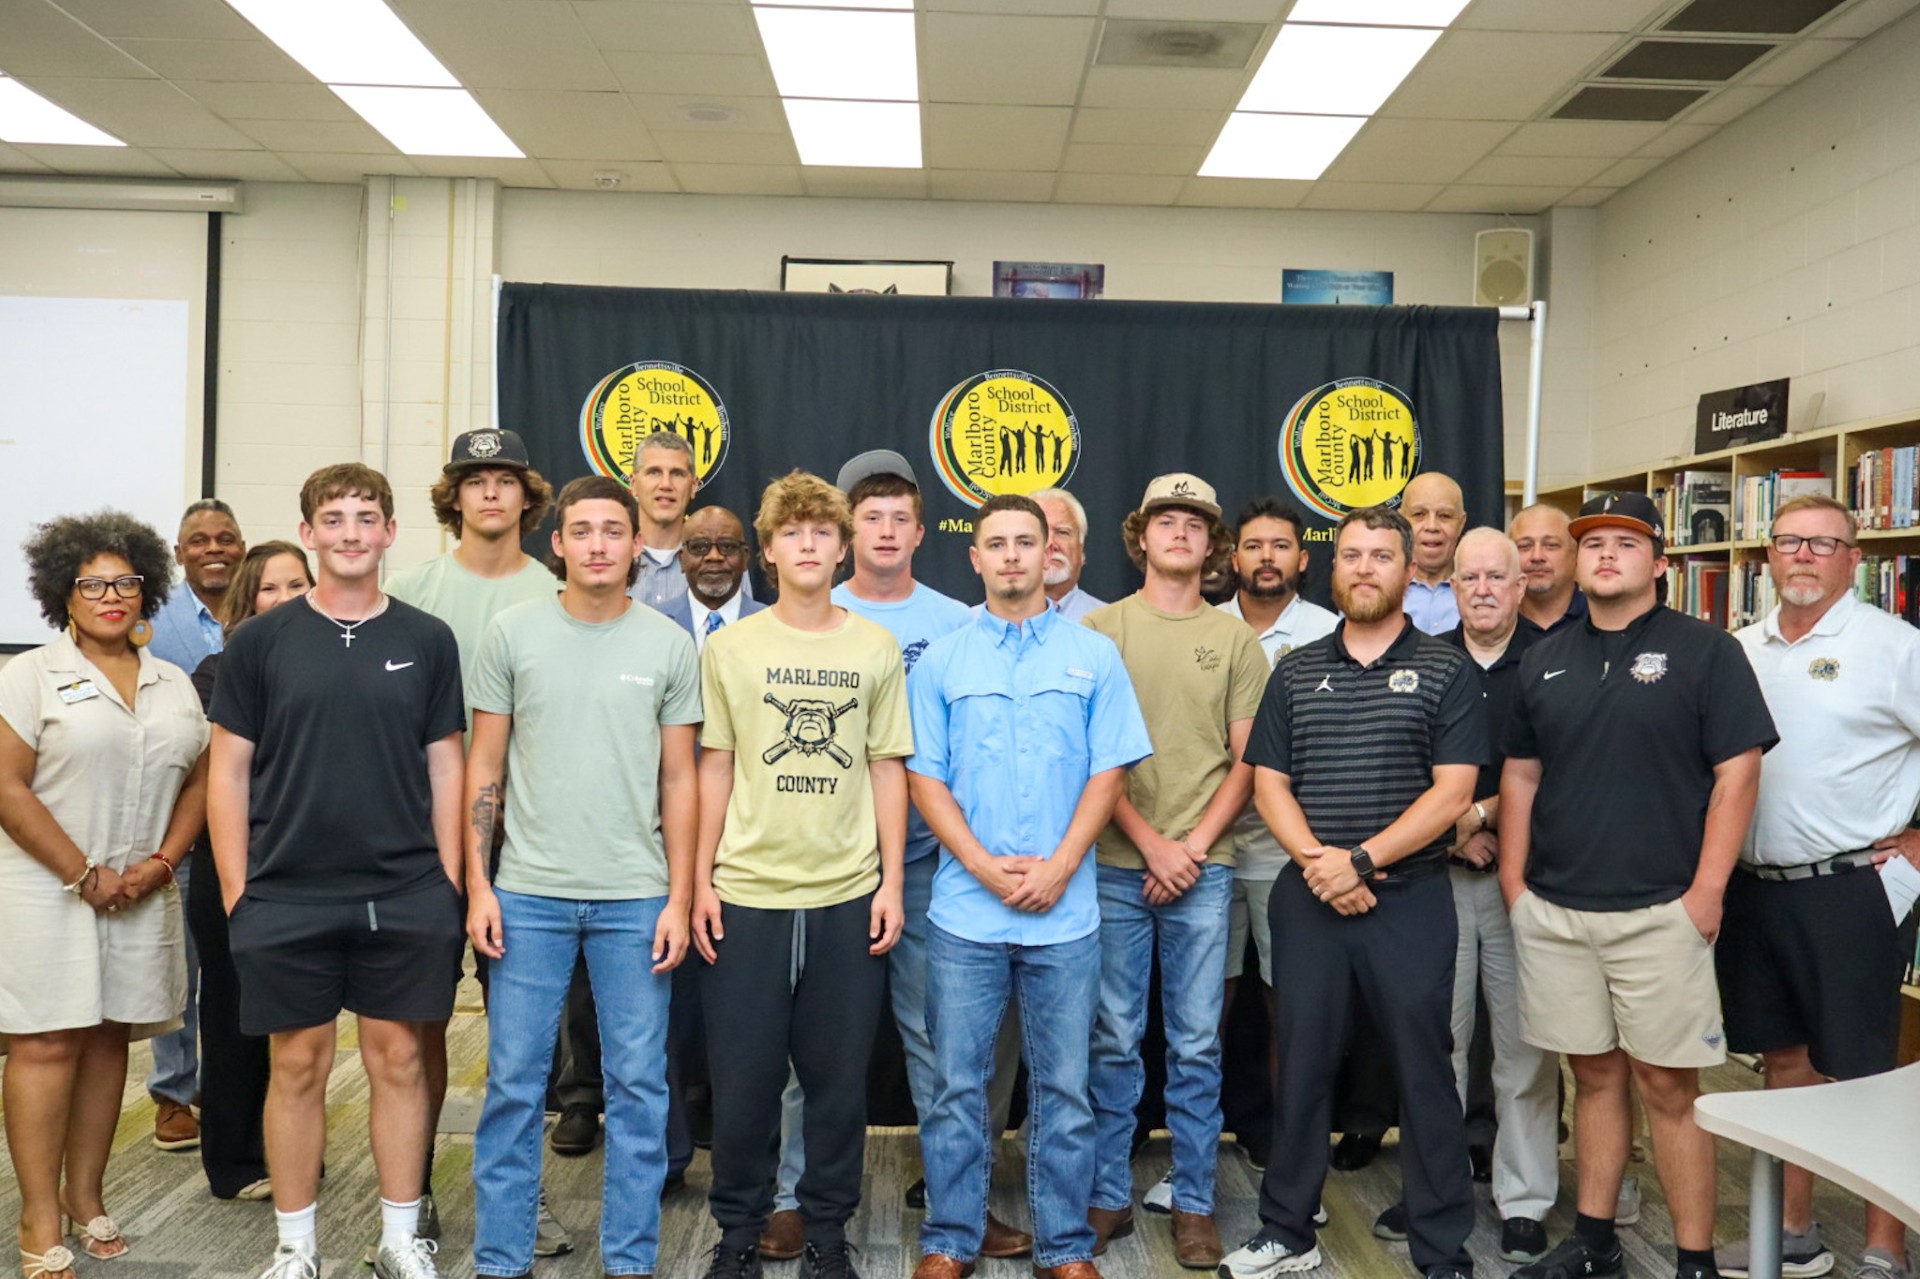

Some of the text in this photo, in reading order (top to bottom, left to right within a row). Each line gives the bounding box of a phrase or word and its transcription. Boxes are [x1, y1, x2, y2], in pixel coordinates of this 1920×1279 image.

[637, 377, 685, 392] School
[987, 386, 1034, 401] School
[650, 390, 701, 405] District
[999, 400, 1052, 414] District
[1337, 395, 1384, 408] School
[1349, 407, 1400, 421] District
[1711, 408, 1768, 432] Literature
[616, 383, 633, 466] Marlboro
[633, 406, 648, 446] unty
[965, 391, 983, 477] Marlboro
[981, 415, 997, 478] County
[1315, 400, 1332, 485] Marlboro
[1331, 425, 1347, 487] County
[938, 518, 973, 533] #Ma
[1303, 527, 1336, 542] Marl
[766, 667, 860, 689] MARLBORO
[777, 774, 838, 794] COUNTY
